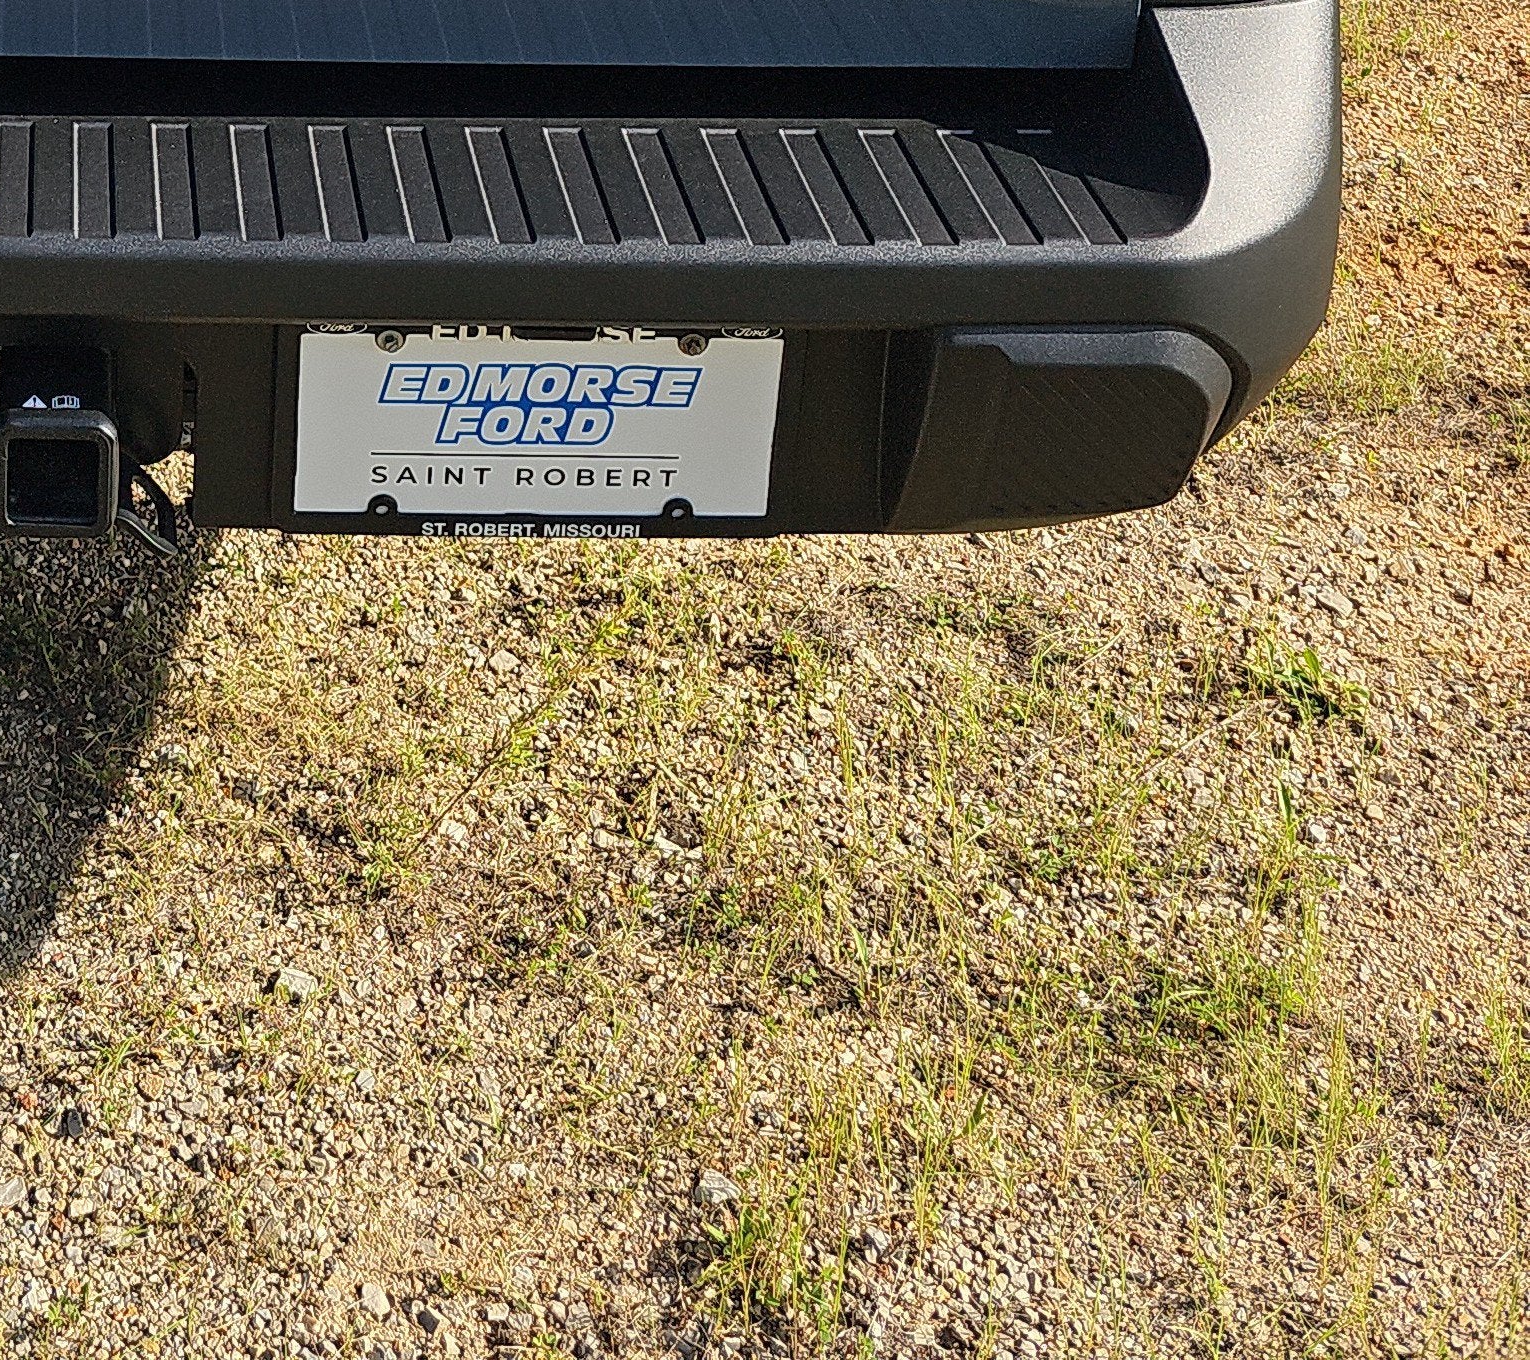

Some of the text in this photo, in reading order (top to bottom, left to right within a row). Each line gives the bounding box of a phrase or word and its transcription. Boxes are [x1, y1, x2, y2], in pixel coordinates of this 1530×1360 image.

[377, 362, 703, 408] ED MORSE
[434, 404, 615, 446] FORD
[370, 466, 678, 488] SAINT ROBERT
[421, 521, 641, 538] ST. ROBERT, MISSOURI
